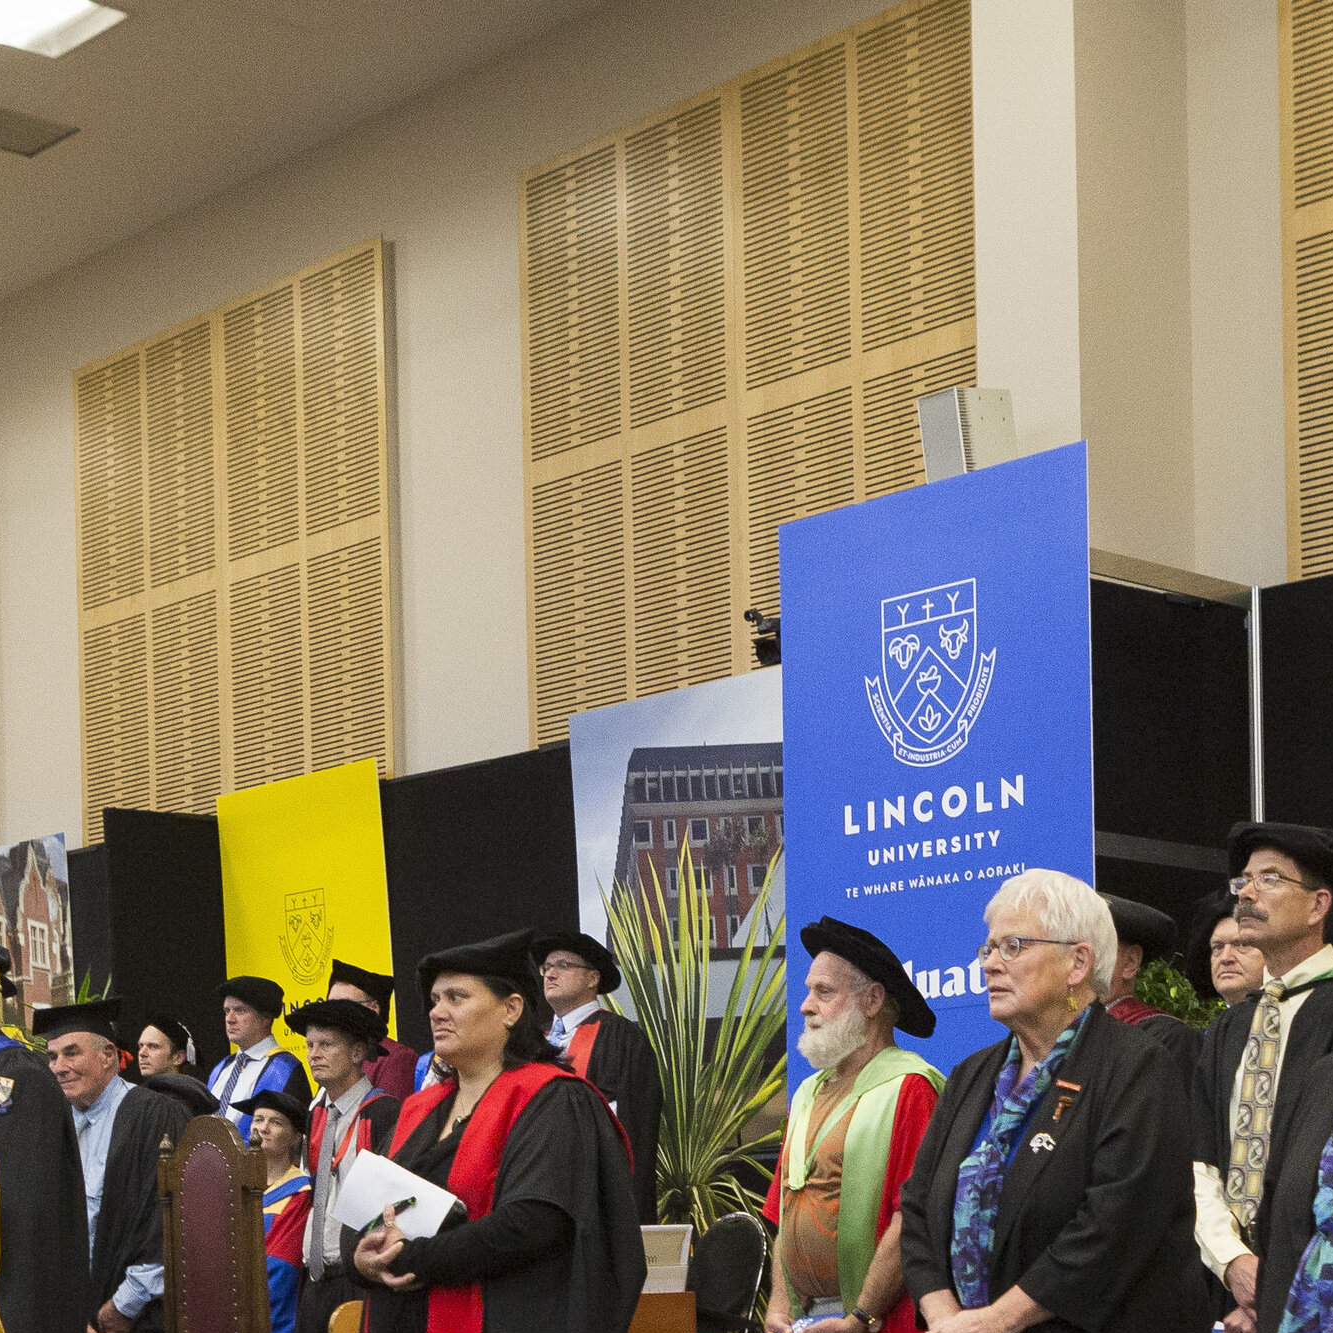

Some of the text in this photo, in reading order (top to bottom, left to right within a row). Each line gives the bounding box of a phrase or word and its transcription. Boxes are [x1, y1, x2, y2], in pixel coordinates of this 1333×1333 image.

[967, 665, 990, 718] PROBITATE
[871, 693, 893, 734] SCIENTIA
[843, 774, 1025, 836] LINCOLN
[867, 829, 1001, 866] UNIVERSITY
[845, 862, 1026, 899] TE WHARE WĀNAKA O AORAKI
